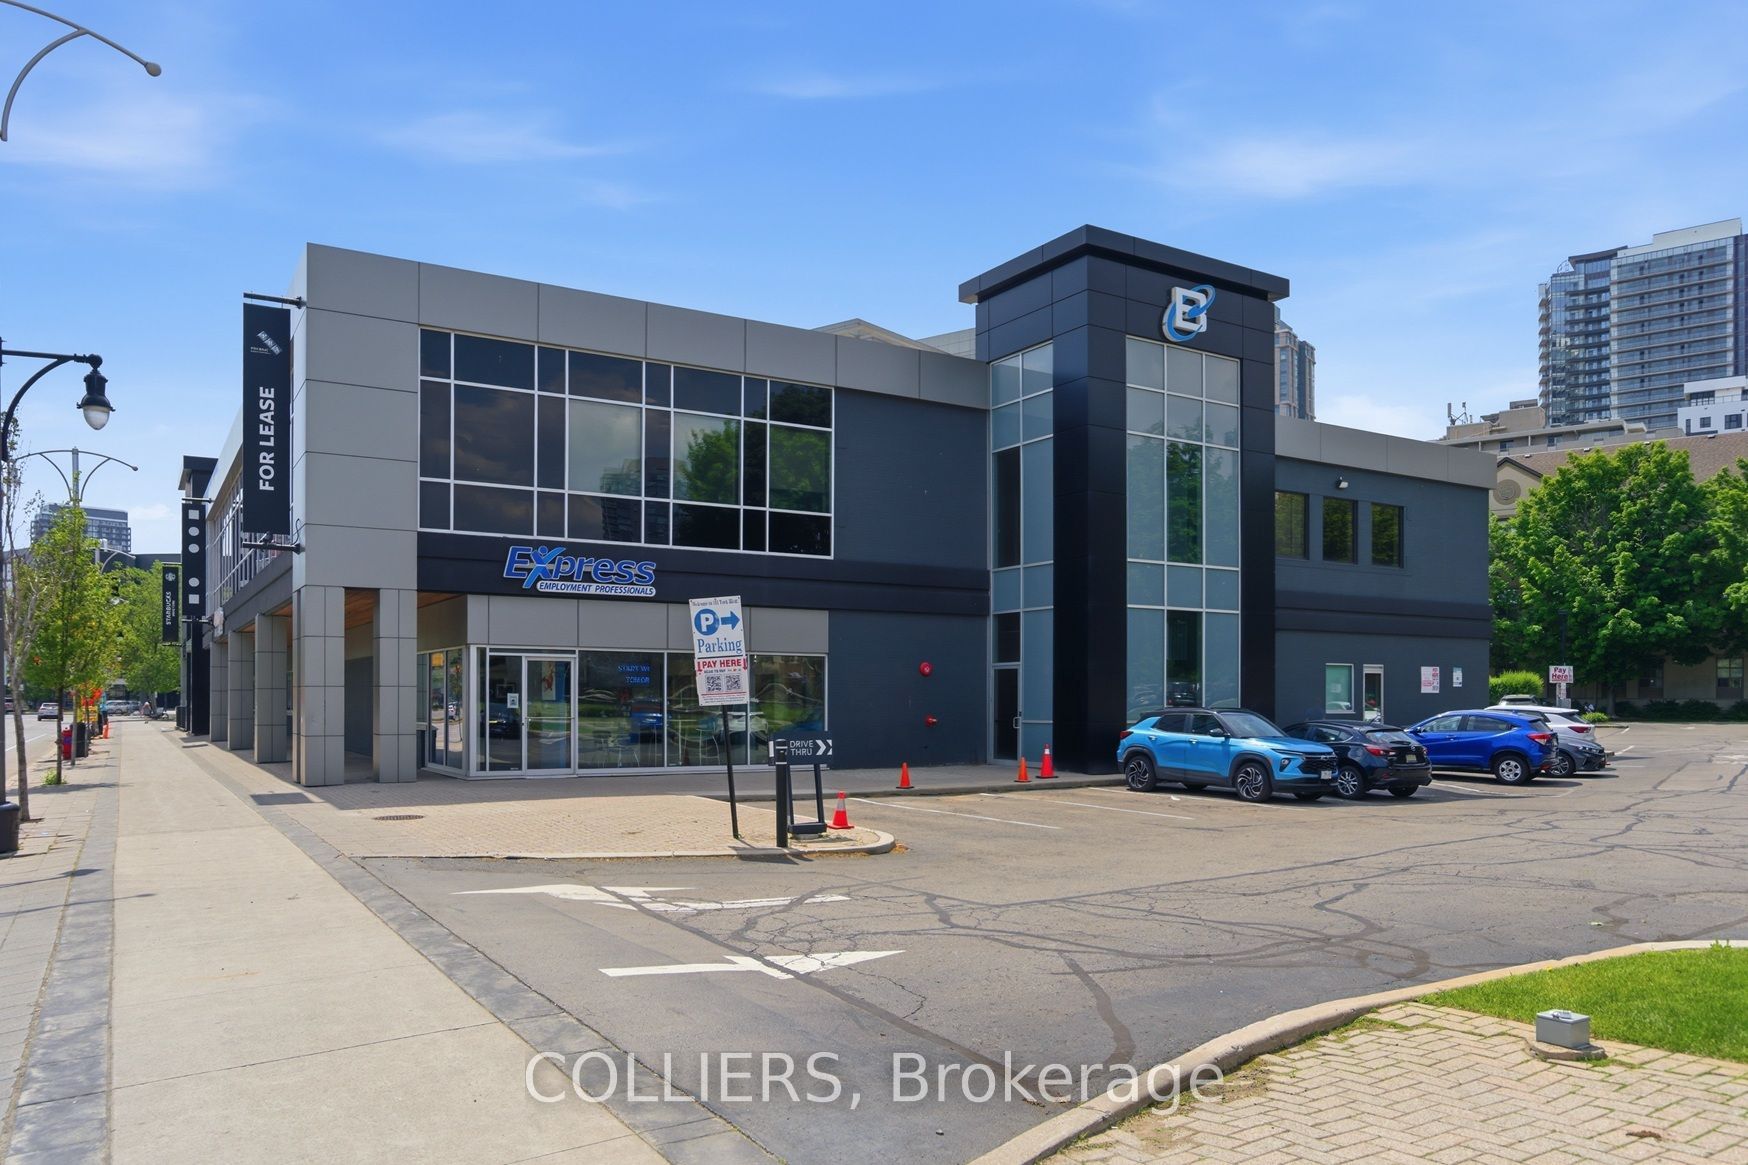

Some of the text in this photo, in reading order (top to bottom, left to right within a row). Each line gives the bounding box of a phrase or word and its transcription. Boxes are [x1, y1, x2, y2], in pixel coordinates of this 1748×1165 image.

[259, 386, 275, 491] FOR LEASE
[539, 582, 654, 596] EMPLOYMENT PROFESSIONALS
[700, 613, 714, 632] P
[697, 638, 742, 654] Parking
[702, 658, 742, 669] PAY HERE
[790, 740, 814, 748] DRIVE
[790, 748, 813, 756] THRU
